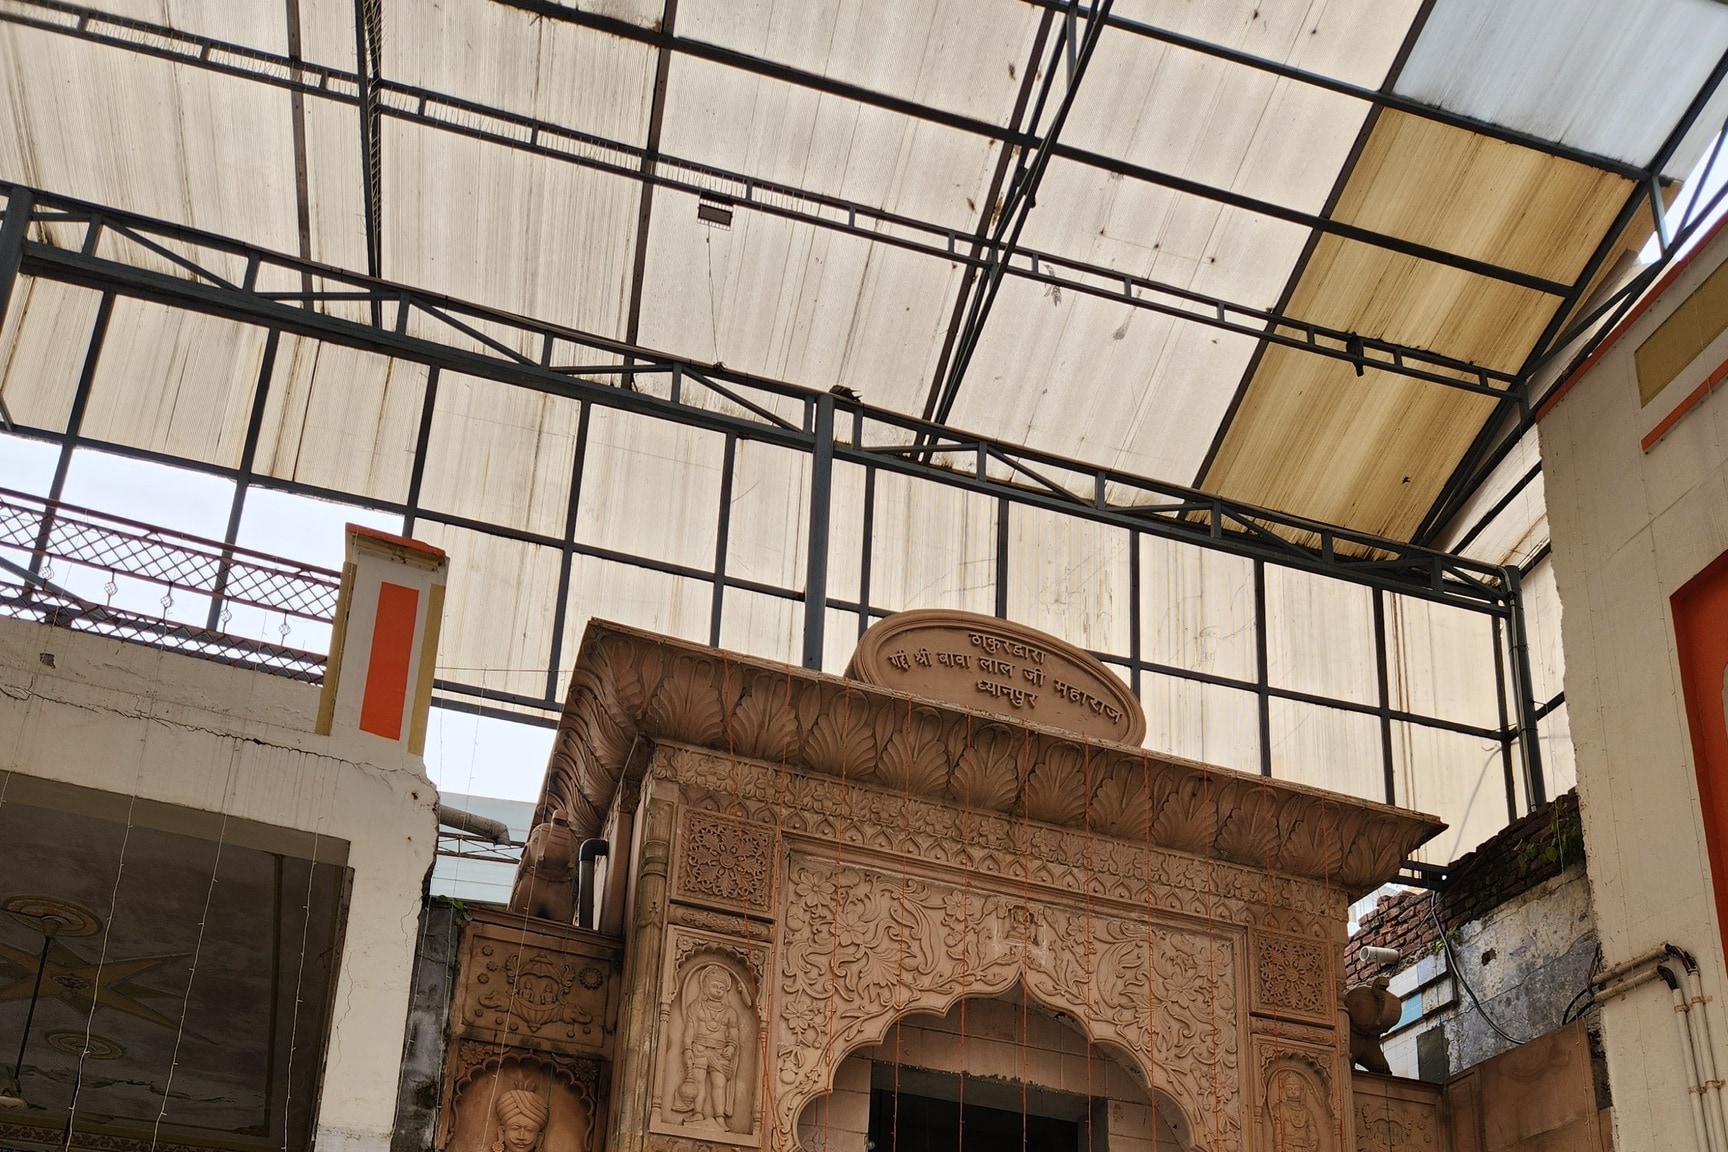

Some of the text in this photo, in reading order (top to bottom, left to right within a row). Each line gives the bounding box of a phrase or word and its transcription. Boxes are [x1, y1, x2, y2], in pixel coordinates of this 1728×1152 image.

[968, 632, 1047, 664] ठाकुरद्वारा
[914, 647, 932, 667] श्री
[978, 656, 1016, 677] लाल
[1023, 667, 1046, 686] जी
[1055, 679, 1123, 723] महाराज
[976, 679, 1038, 708] ध्यानपुर
